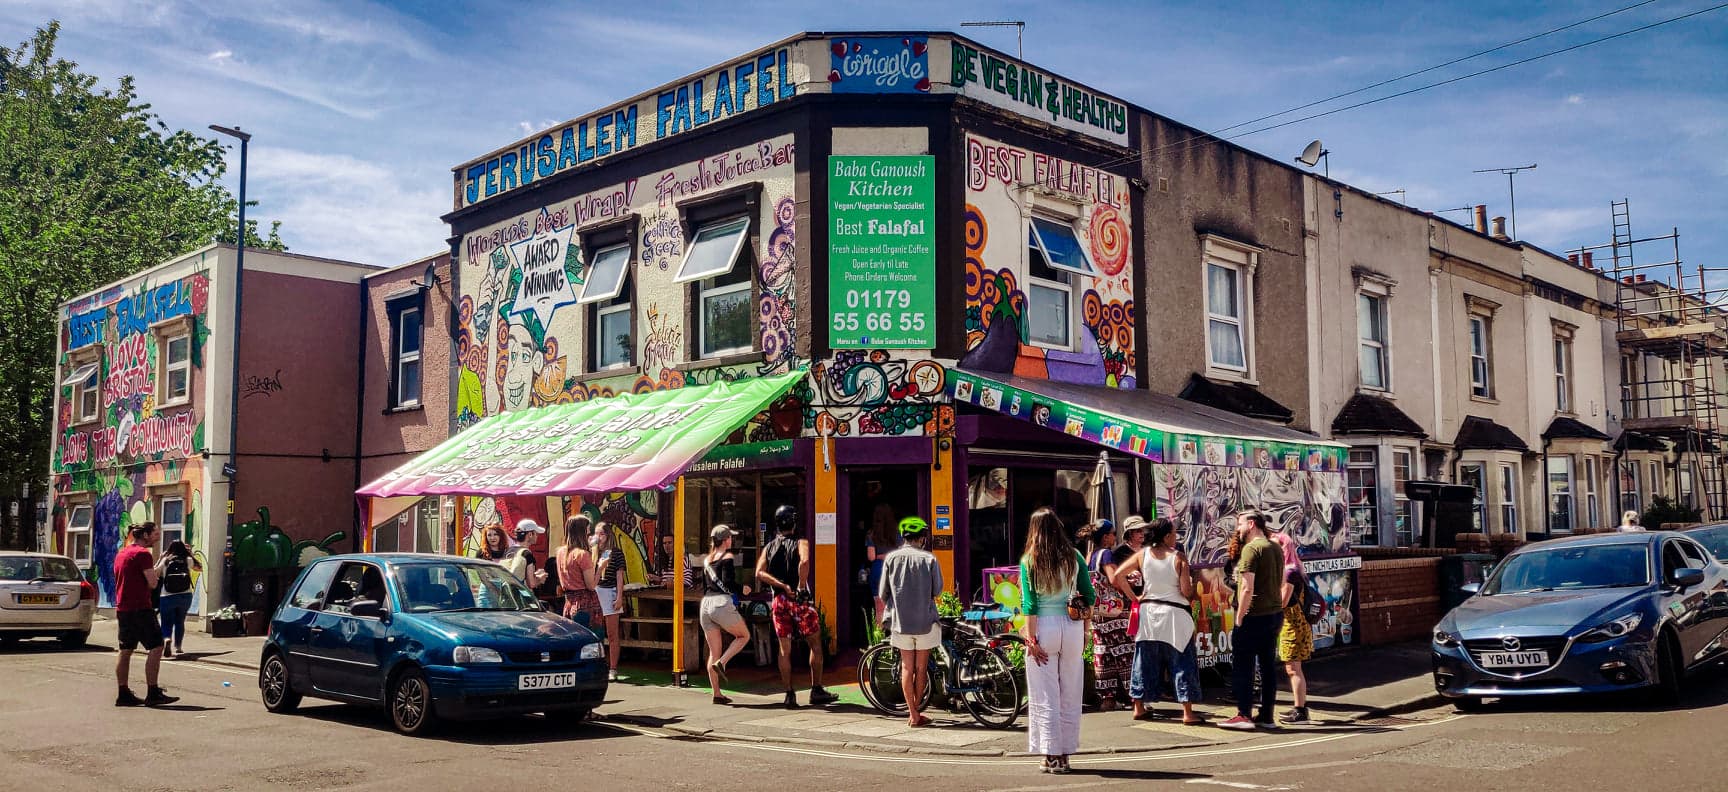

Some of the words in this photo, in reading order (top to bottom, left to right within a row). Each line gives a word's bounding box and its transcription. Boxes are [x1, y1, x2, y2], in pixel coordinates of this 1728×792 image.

[843, 47, 925, 87] Wriggle
[951, 41, 978, 87] BE
[980, 54, 1043, 109] VEGAN
[1045, 78, 1060, 121] &
[1062, 83, 1127, 135] HEALTHY
[466, 104, 638, 205] JERUSALEM
[656, 48, 797, 140] FALAFEL
[835, 160, 867, 177] Baba
[870, 160, 925, 177] Ganoush
[967, 137, 1026, 192] BEST
[656, 158, 713, 208] Fresh
[848, 180, 913, 196] Kitchen
[893, 201, 925, 211] Specialist
[836, 218, 863, 235] Best
[523, 238, 560, 273] AWARD
[832, 244, 850, 254] Fresh
[851, 244, 869, 254] Juice
[869, 244, 881, 254] and
[882, 244, 907, 256] Organic
[908, 244, 929, 254] Coffee
[852, 258, 869, 270] Open
[869, 258, 886, 270] Early
[894, 259, 909, 269] Late
[844, 271, 865, 281] Phone
[865, 271, 888, 281] Orders
[888, 271, 917, 281] Welcome
[846, 289, 911, 308] 01179
[70, 306, 108, 349] BEST
[833, 312, 859, 331] 55
[866, 312, 892, 331] 66
[899, 312, 925, 331] 55
[104, 367, 155, 408] BRISTOL
[129, 408, 194, 458] COMMUNITY
[686, 461, 718, 473] erusalem
[719, 456, 745, 470] Falafel
[1487, 652, 1513, 665] YB14
[1516, 652, 1541, 665] UYD
[523, 675, 550, 688] S377
[553, 674, 573, 686] CTC
